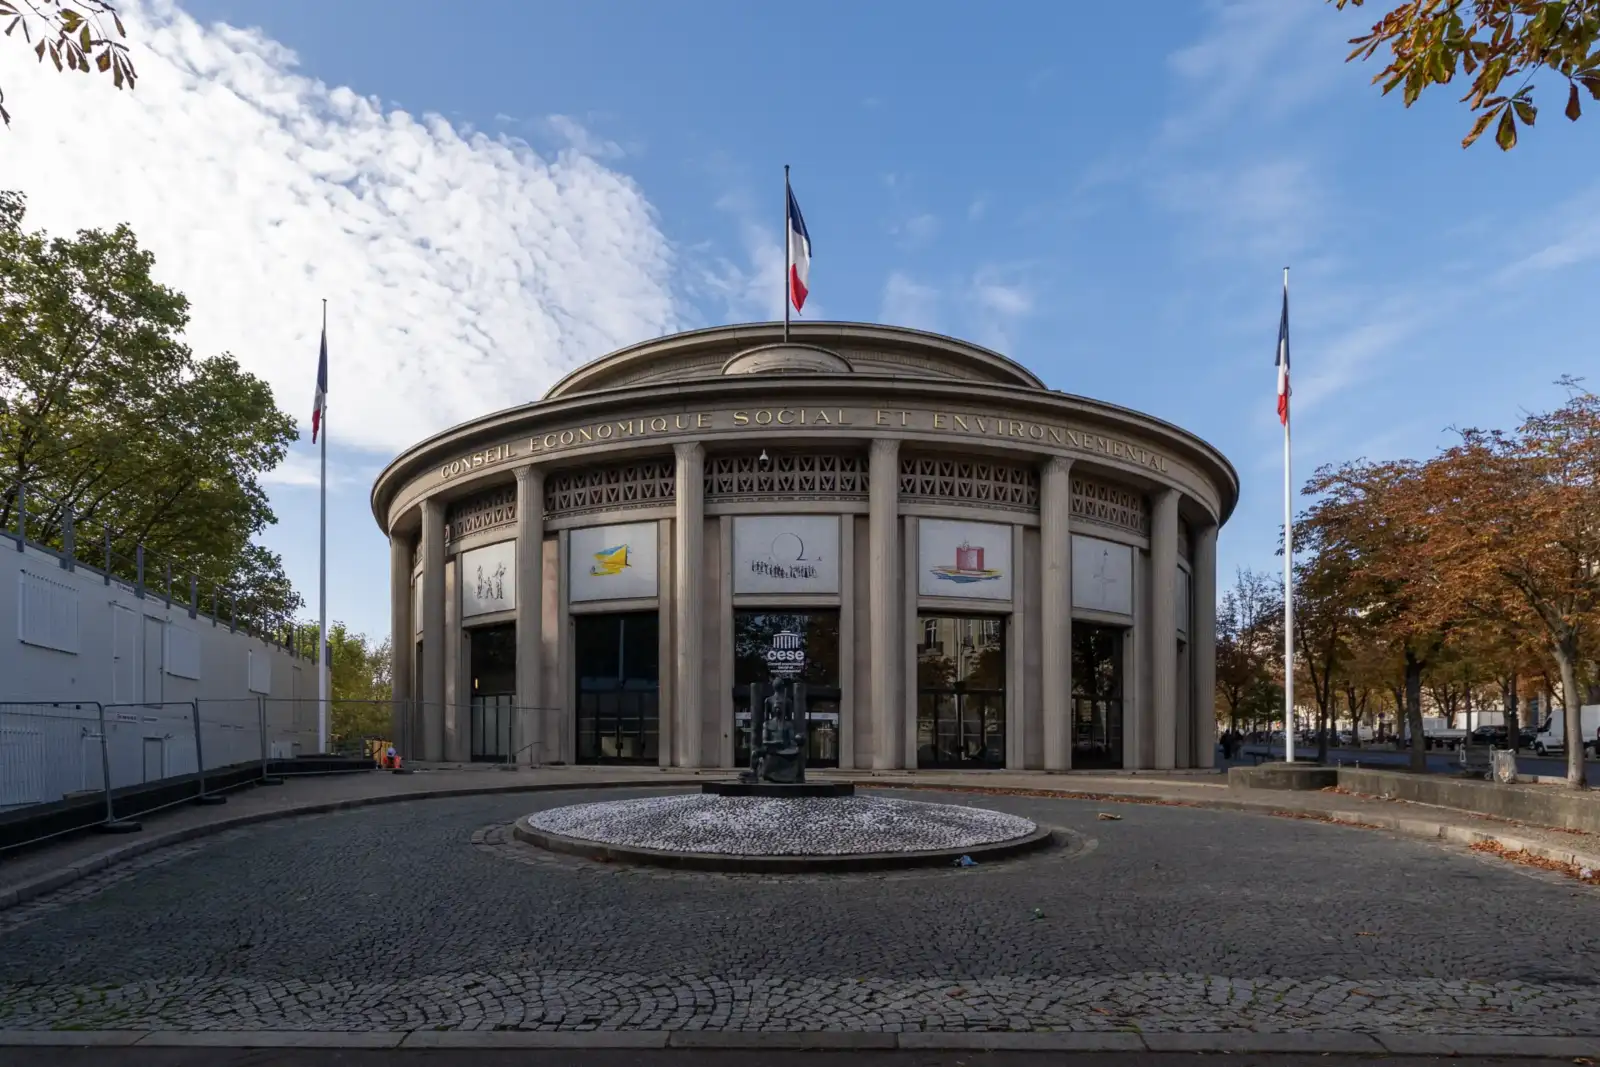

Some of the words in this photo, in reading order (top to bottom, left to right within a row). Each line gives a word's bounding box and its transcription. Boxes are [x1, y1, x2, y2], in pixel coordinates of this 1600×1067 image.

[441, 443, 517, 479] CONSEIL
[530, 413, 713, 450] ECONOMIQUE
[733, 409, 852, 426] SOCIAL
[876, 410, 912, 427] ET
[933, 412, 1168, 474] ENVIRONNEMENTAL
[767, 650, 804, 660] cese
